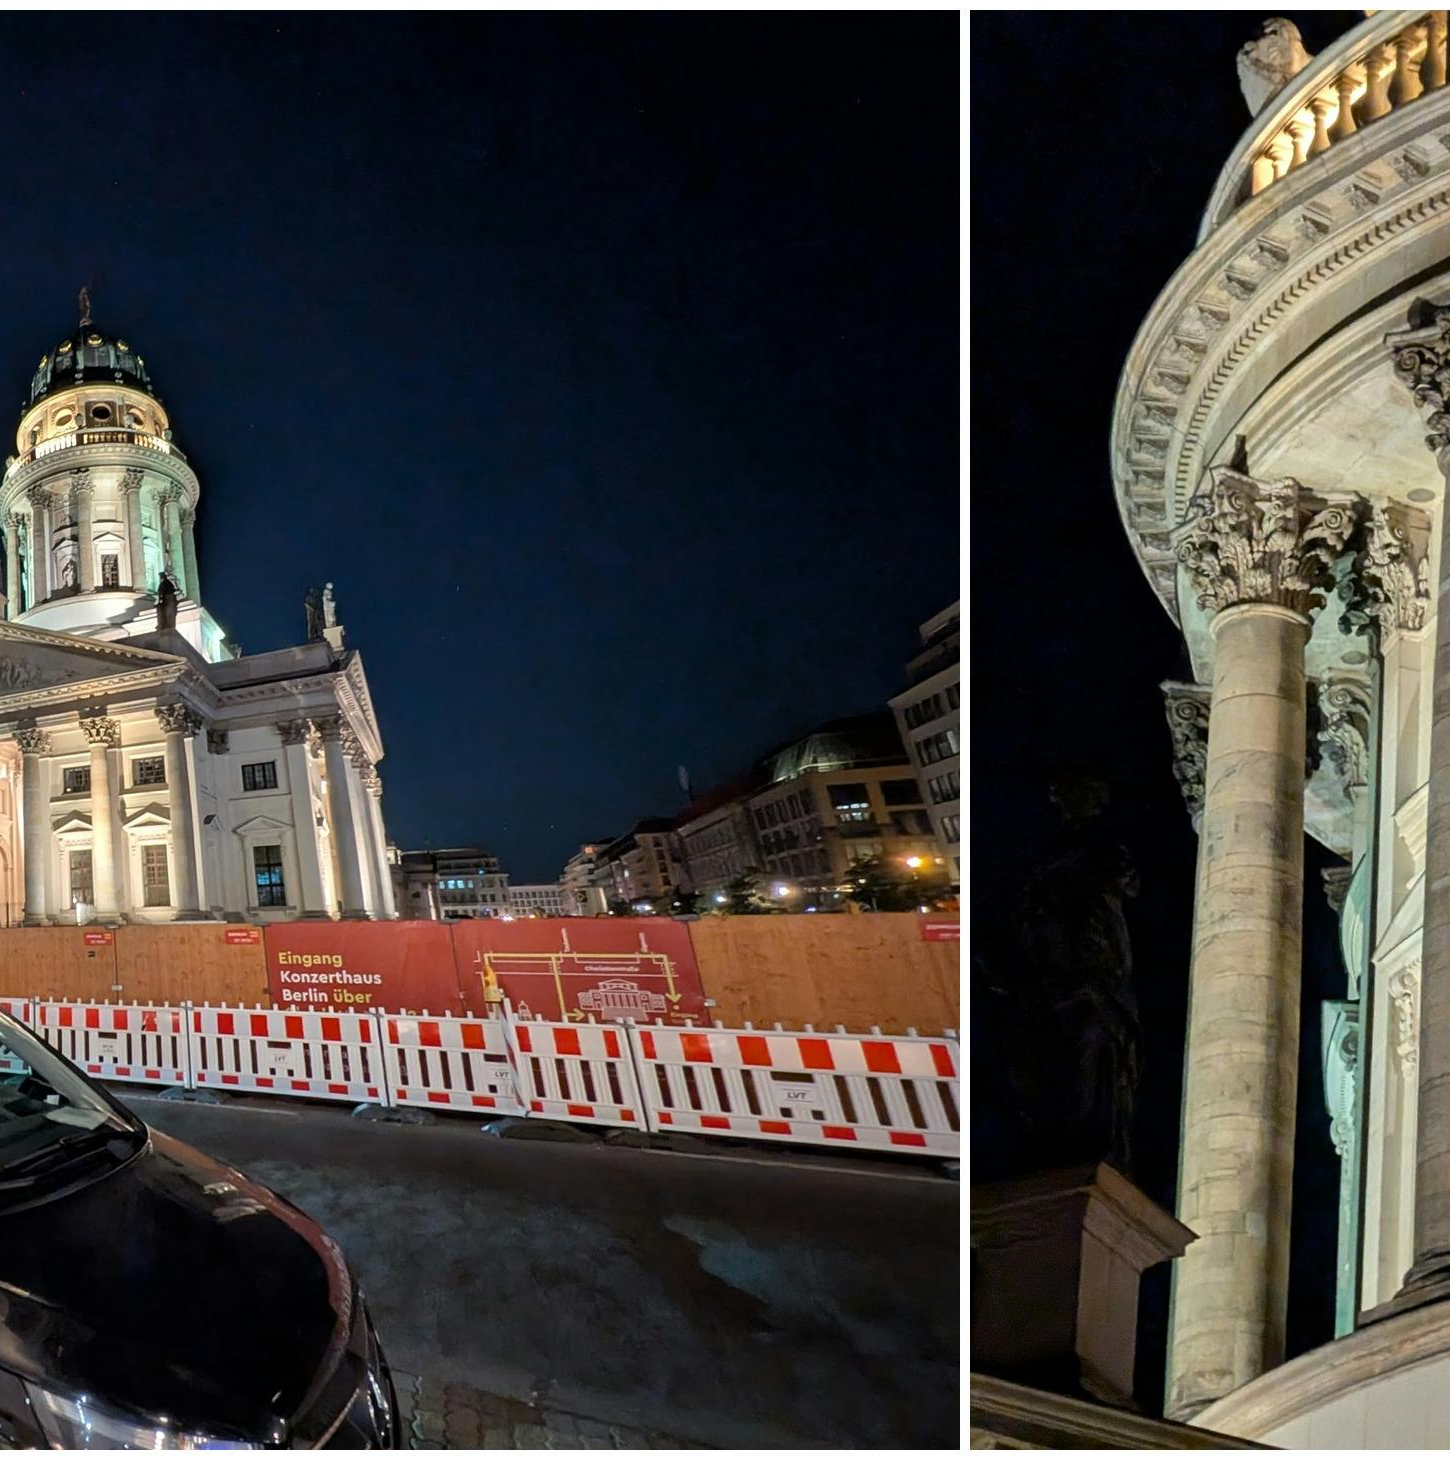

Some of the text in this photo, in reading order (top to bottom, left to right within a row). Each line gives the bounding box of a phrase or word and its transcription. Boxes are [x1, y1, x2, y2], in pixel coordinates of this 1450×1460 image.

[278, 951, 343, 968] Eingang
[280, 970, 382, 985] Konzerthaus
[282, 988, 373, 1004] Berlin über
[787, 1091, 807, 1100] LVT
